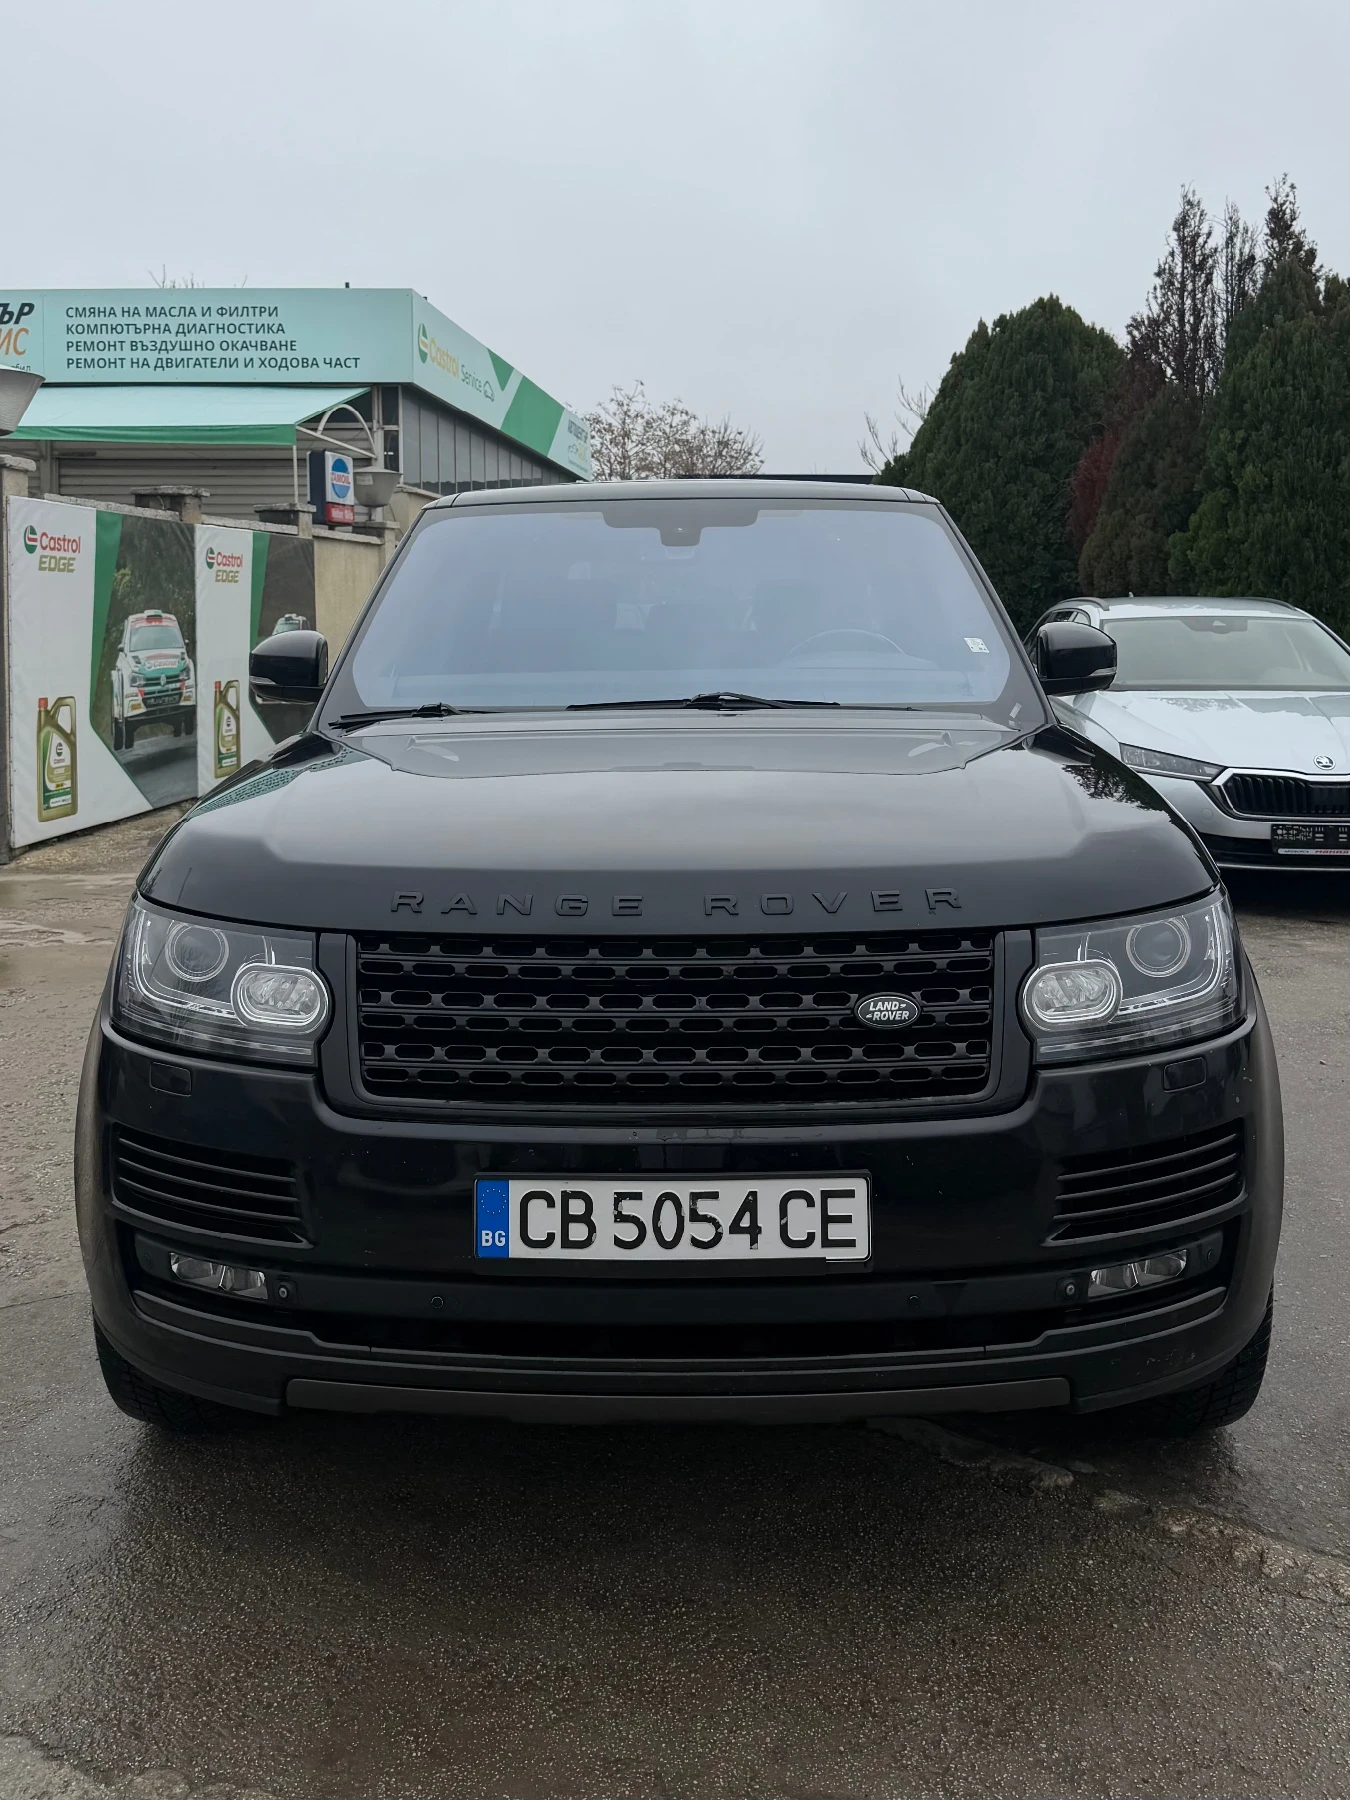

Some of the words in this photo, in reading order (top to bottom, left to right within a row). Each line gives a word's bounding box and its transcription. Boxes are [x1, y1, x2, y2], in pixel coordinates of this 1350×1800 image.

[65, 306, 117, 318] СМЯНА
[121, 306, 141, 318] НА
[145, 306, 197, 318] МАСЛА
[201, 306, 212, 318] И
[216, 306, 278, 318] ФИЛТРИ
[66, 323, 172, 335] КОМПЮТЪРНА
[175, 323, 286, 338] ДИАГНОСТИКА
[66, 340, 126, 352] РЕМОНТ
[130, 340, 215, 354] ВЪЗДУШНО
[219, 340, 297, 352] ОКАЧВАНЕ
[66, 357, 127, 369] РЕМОНТ
[130, 357, 151, 369] НА
[154, 357, 239, 371] ДВИГАТЕЛИ
[243, 357, 254, 369] И
[259, 357, 320, 372] ХОДОВА
[323, 357, 361, 369] ЧАСТ
[429, 337, 460, 378] Castrol
[461, 364, 482, 393] Service
[40, 531, 81, 554] Castrol
[38, 554, 76, 573] EDGE
[216, 551, 243, 568] Castrol
[215, 569, 240, 583] EDGE
[391, 891, 643, 916] RANGE
[703, 888, 962, 916] ROVER
[869, 1001, 899, 1011] LAND
[873, 1010, 909, 1021] ROVER
[519, 1189, 597, 1250] CB
[613, 1190, 763, 1250] 5054
[778, 1188, 857, 1249] CE
[481, 1230, 506, 1247] BG
